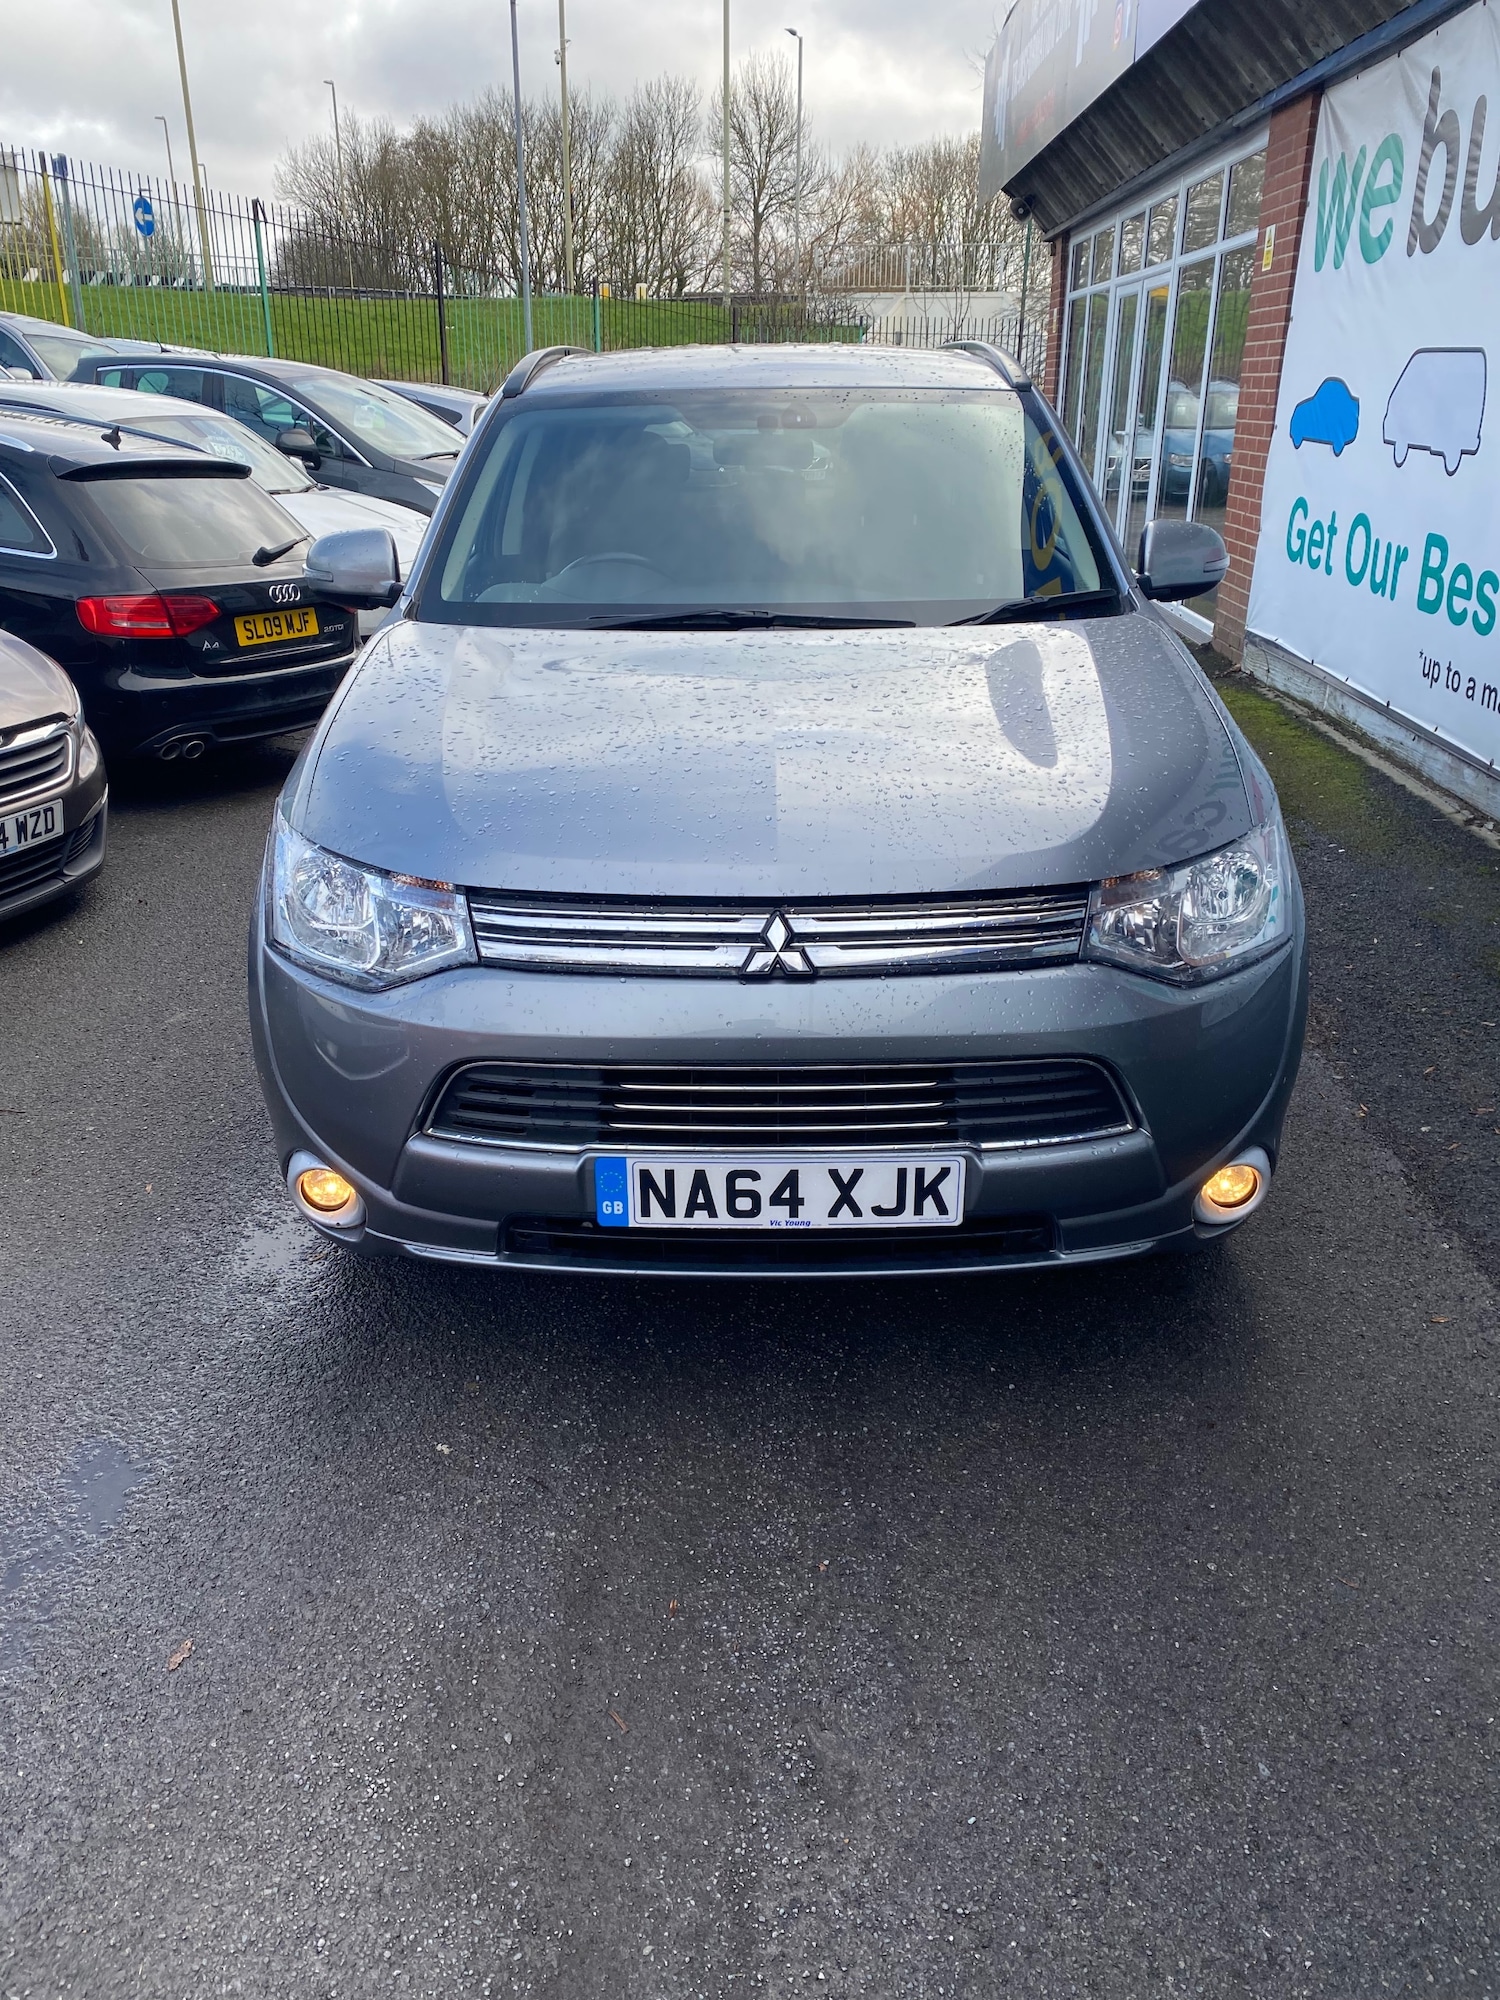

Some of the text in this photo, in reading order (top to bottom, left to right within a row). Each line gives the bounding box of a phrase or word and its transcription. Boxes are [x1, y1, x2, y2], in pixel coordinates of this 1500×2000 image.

[1286, 496, 1500, 637] Get Our Bes
[243, 611, 310, 641] SL09 MJF
[202, 639, 220, 652] A4
[1445, 660, 1461, 693] to
[1465, 676, 1477, 701] a
[1480, 682, 1500, 715] m
[15, 806, 55, 845] WZD
[602, 1200, 624, 1215] GB
[638, 1166, 952, 1220] NA64 XJK
[769, 1219, 782, 1227] Vic
[784, 1219, 812, 1227] Young
